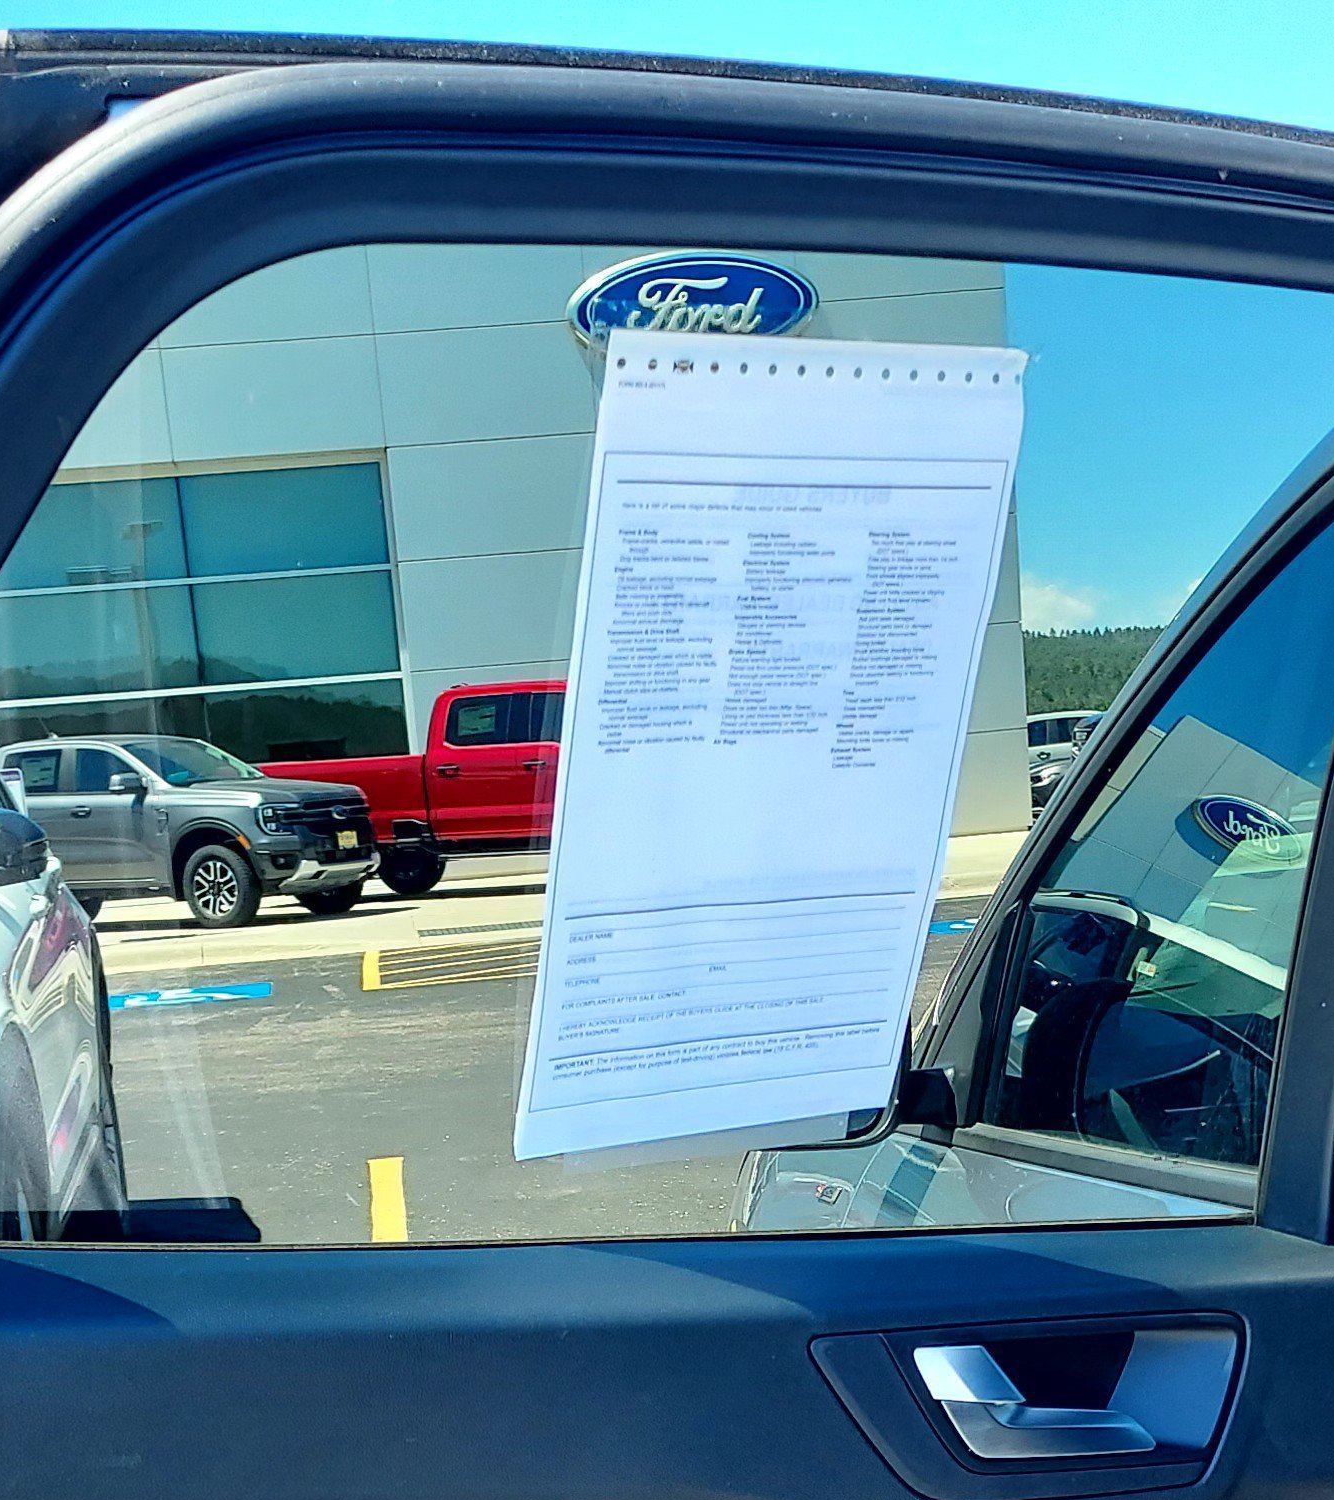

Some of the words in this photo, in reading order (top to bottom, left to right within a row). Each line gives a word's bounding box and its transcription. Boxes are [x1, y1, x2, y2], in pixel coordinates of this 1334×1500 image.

[627, 276, 763, 334] Ford
[569, 934, 594, 943] DEALER
[566, 956, 596, 965] ADDRESS
[708, 965, 727, 973] EMAIL
[564, 977, 601, 988] TELEPHONE
